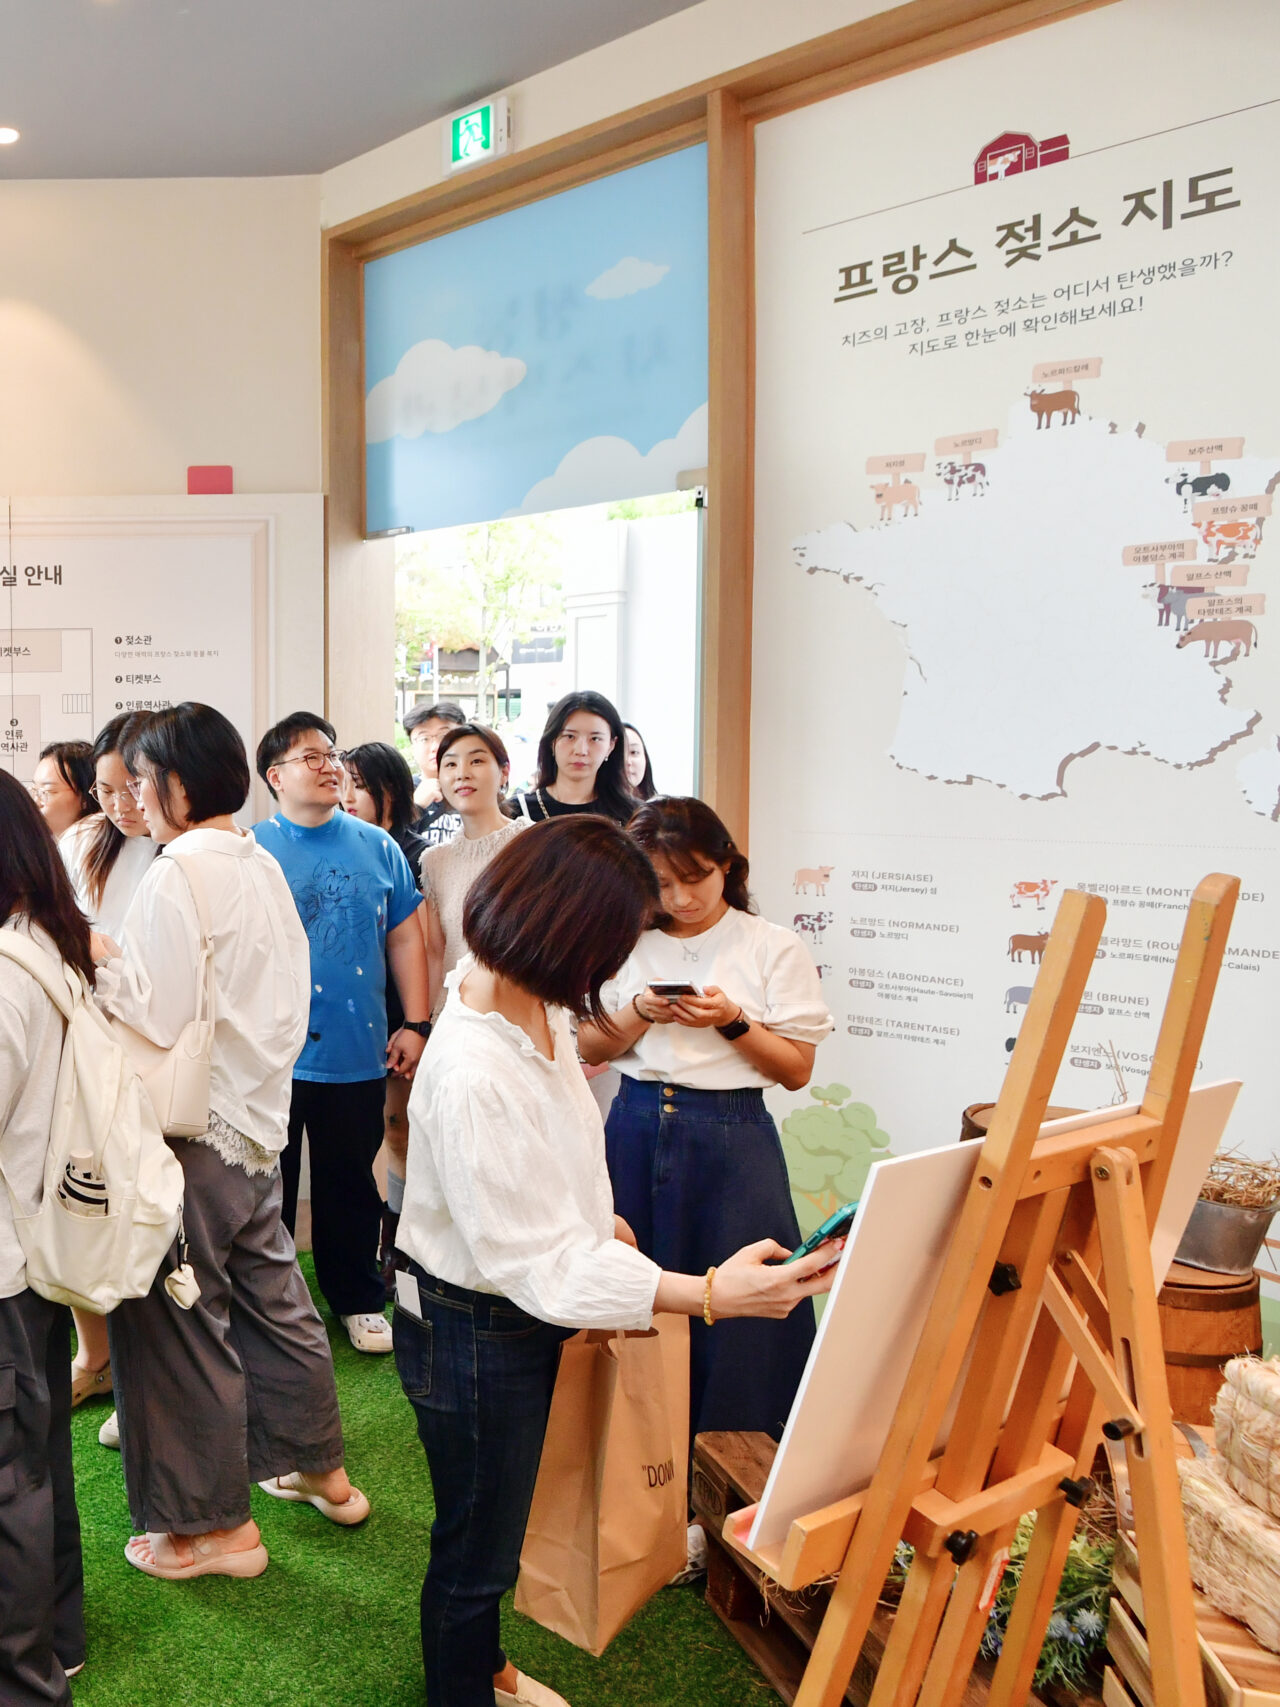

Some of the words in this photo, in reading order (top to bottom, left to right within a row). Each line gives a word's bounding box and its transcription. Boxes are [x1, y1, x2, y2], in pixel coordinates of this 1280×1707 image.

[833, 238, 978, 304] 프랑스
[995, 206, 1102, 268] 젖소
[1120, 166, 1242, 230] 지도
[841, 325, 888, 349] 치즈의
[893, 316, 930, 336] 고장,
[936, 305, 988, 328] 프랑스
[994, 292, 1049, 317] 젖소는
[1053, 275, 1110, 301] 어디서
[1116, 250, 1234, 290] 탄생했을까?
[908, 334, 959, 356] 지도로
[965, 322, 1017, 348] 한눈에
[1022, 296, 1144, 334] 확인해보세요!
[23, 564, 63, 587] 안내
[1186, 572, 1212, 582] 알프스
[1214, 570, 1233, 580] 산맥
[1207, 596, 1244, 608] 알프스의
[124, 635, 152, 646] 젖소관
[125, 674, 162, 685] 티켓부스
[125, 700, 171, 711] 인류역사관
[5, 730, 24, 740] 인류
[0, 742, 29, 753] 역사관
[851, 870, 869, 879] 저지
[871, 871, 934, 883] (JERSIAISE)
[850, 916, 886, 927] 노르망드
[888, 919, 960, 934] (NORMANDE)
[880, 931, 909, 941] 노르망디
[887, 970, 965, 987] (ABONDANCE)
[1097, 992, 1150, 1006] (BRUNE)
[1108, 1007, 1132, 1018] 알프스
[1133, 1010, 1150, 1019] 산맥
[885, 1018, 961, 1036] (TARENTAISE)
